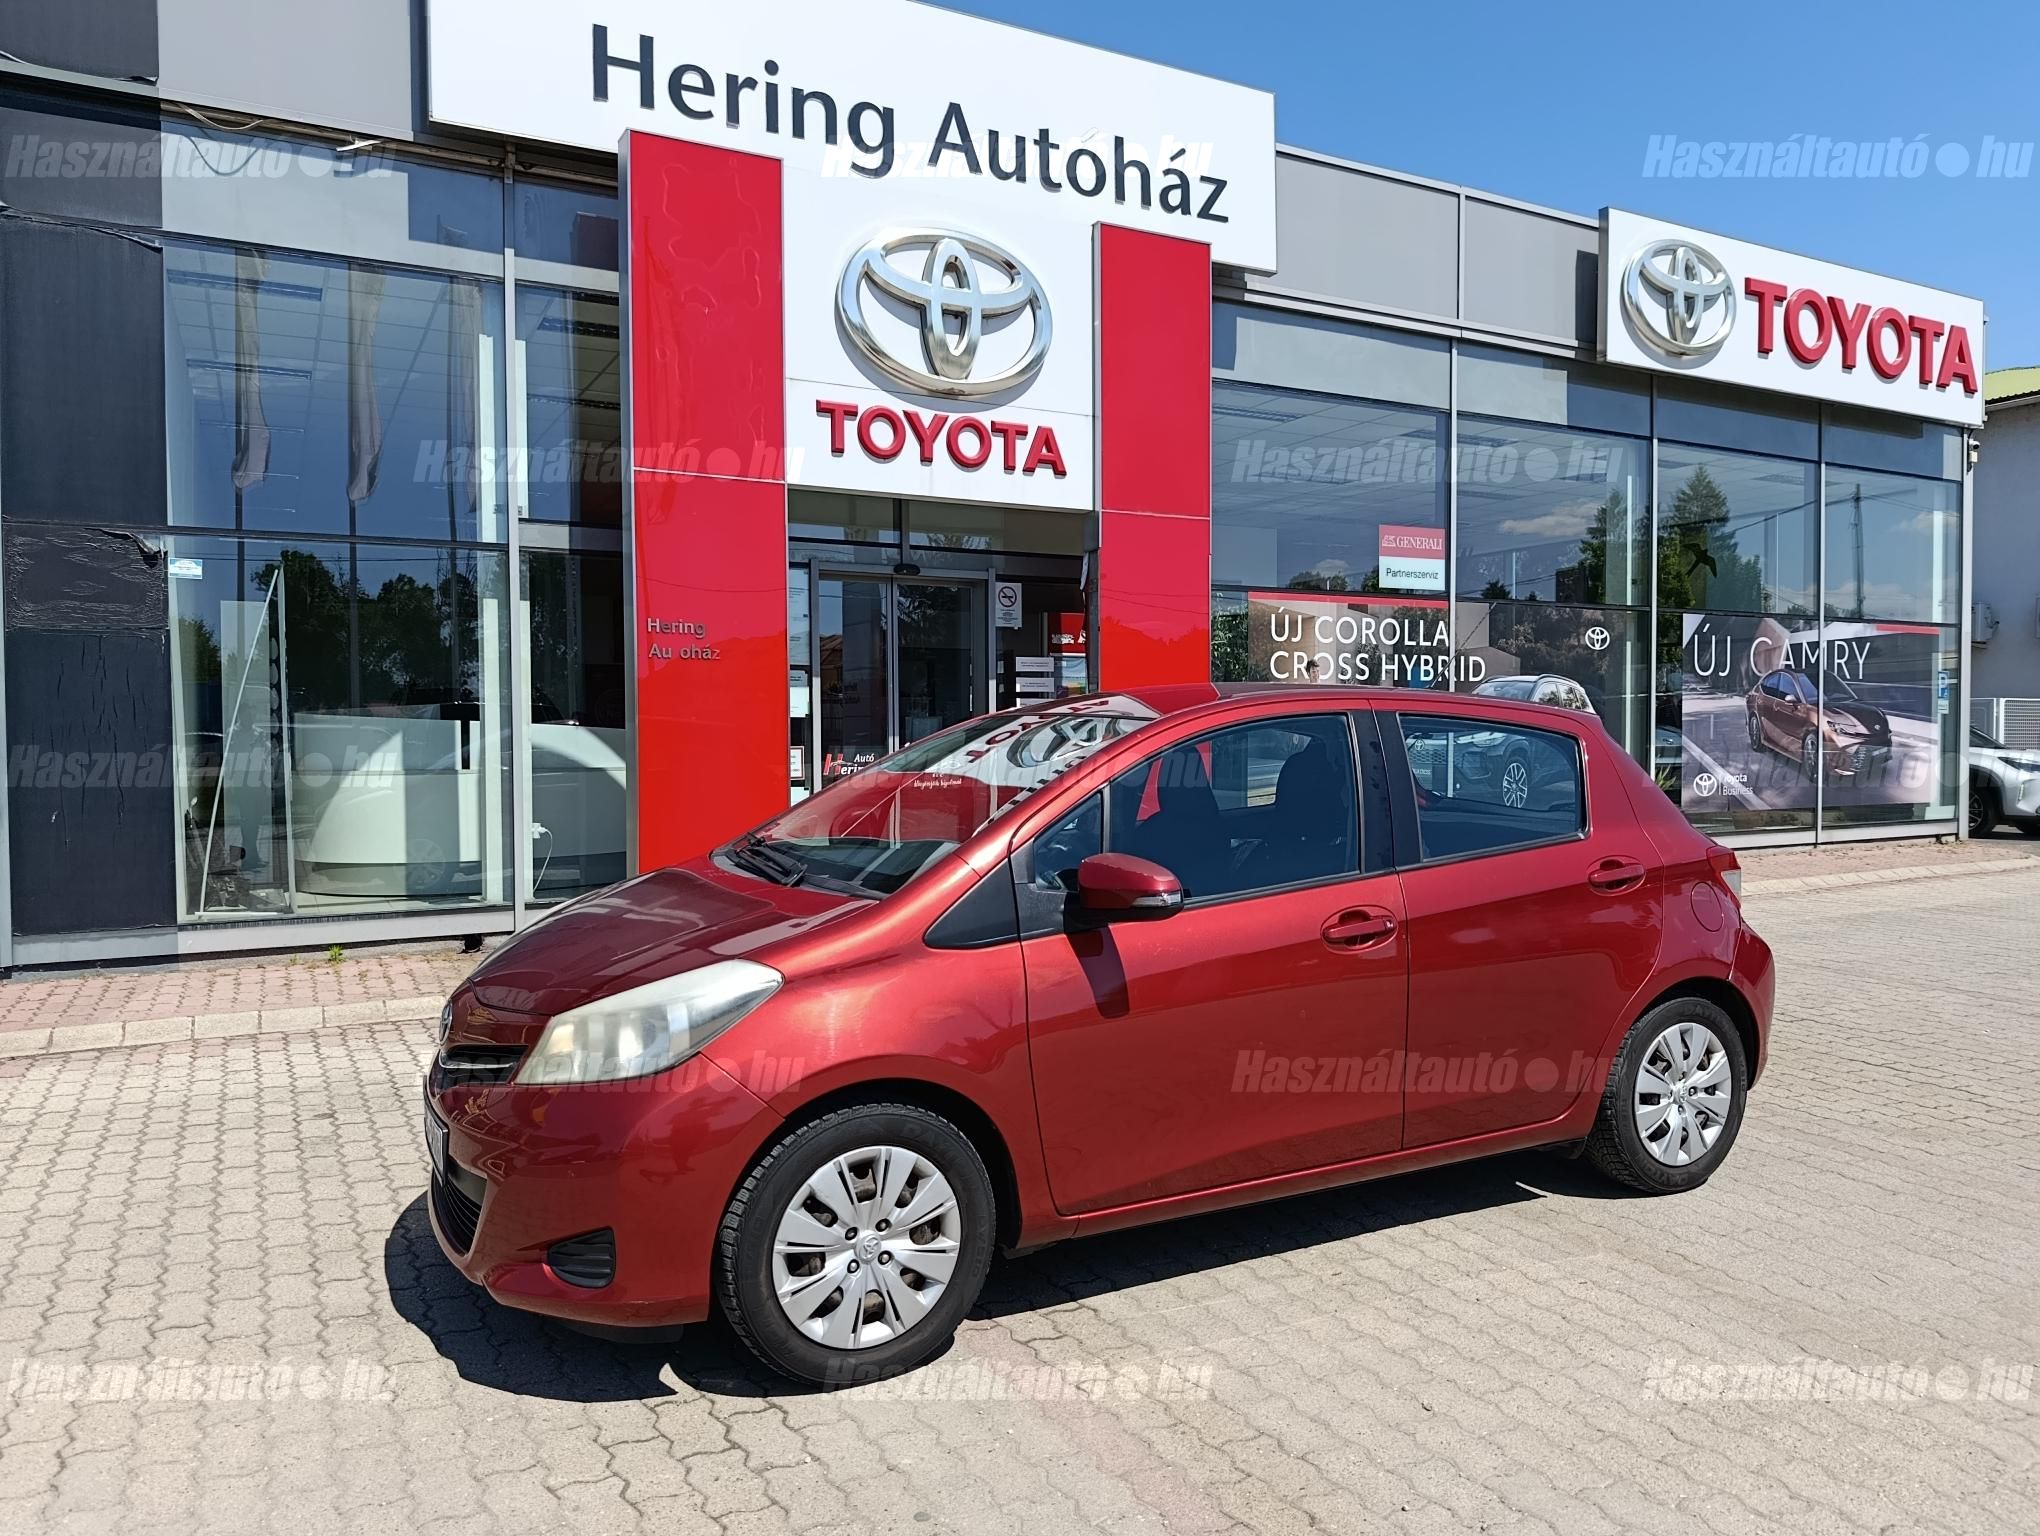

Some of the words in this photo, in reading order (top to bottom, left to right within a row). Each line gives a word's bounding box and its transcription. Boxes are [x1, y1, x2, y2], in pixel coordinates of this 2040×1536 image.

[592, 23, 896, 178] Hering
[928, 101, 1229, 223] Autóház
[1744, 276, 1979, 395] TOYOTA
[815, 399, 1067, 477] TOYOTA
[1396, 535, 1442, 550] GENERALI
[1386, 567, 1439, 580] Partnerszerviz
[647, 617, 706, 639] Hering
[1271, 606, 1302, 642] ÚJ
[1315, 615, 1450, 647] COROLLA
[1694, 623, 1731, 677] ÚJ
[1750, 637, 1871, 679] CAMRY
[1270, 650, 1370, 681] CROSS
[1381, 653, 1487, 682] HYBRID
[853, 752, 875, 763] Autó
[1722, 785, 1754, 796] Business
[1723, 773, 1748, 784] Toyota
